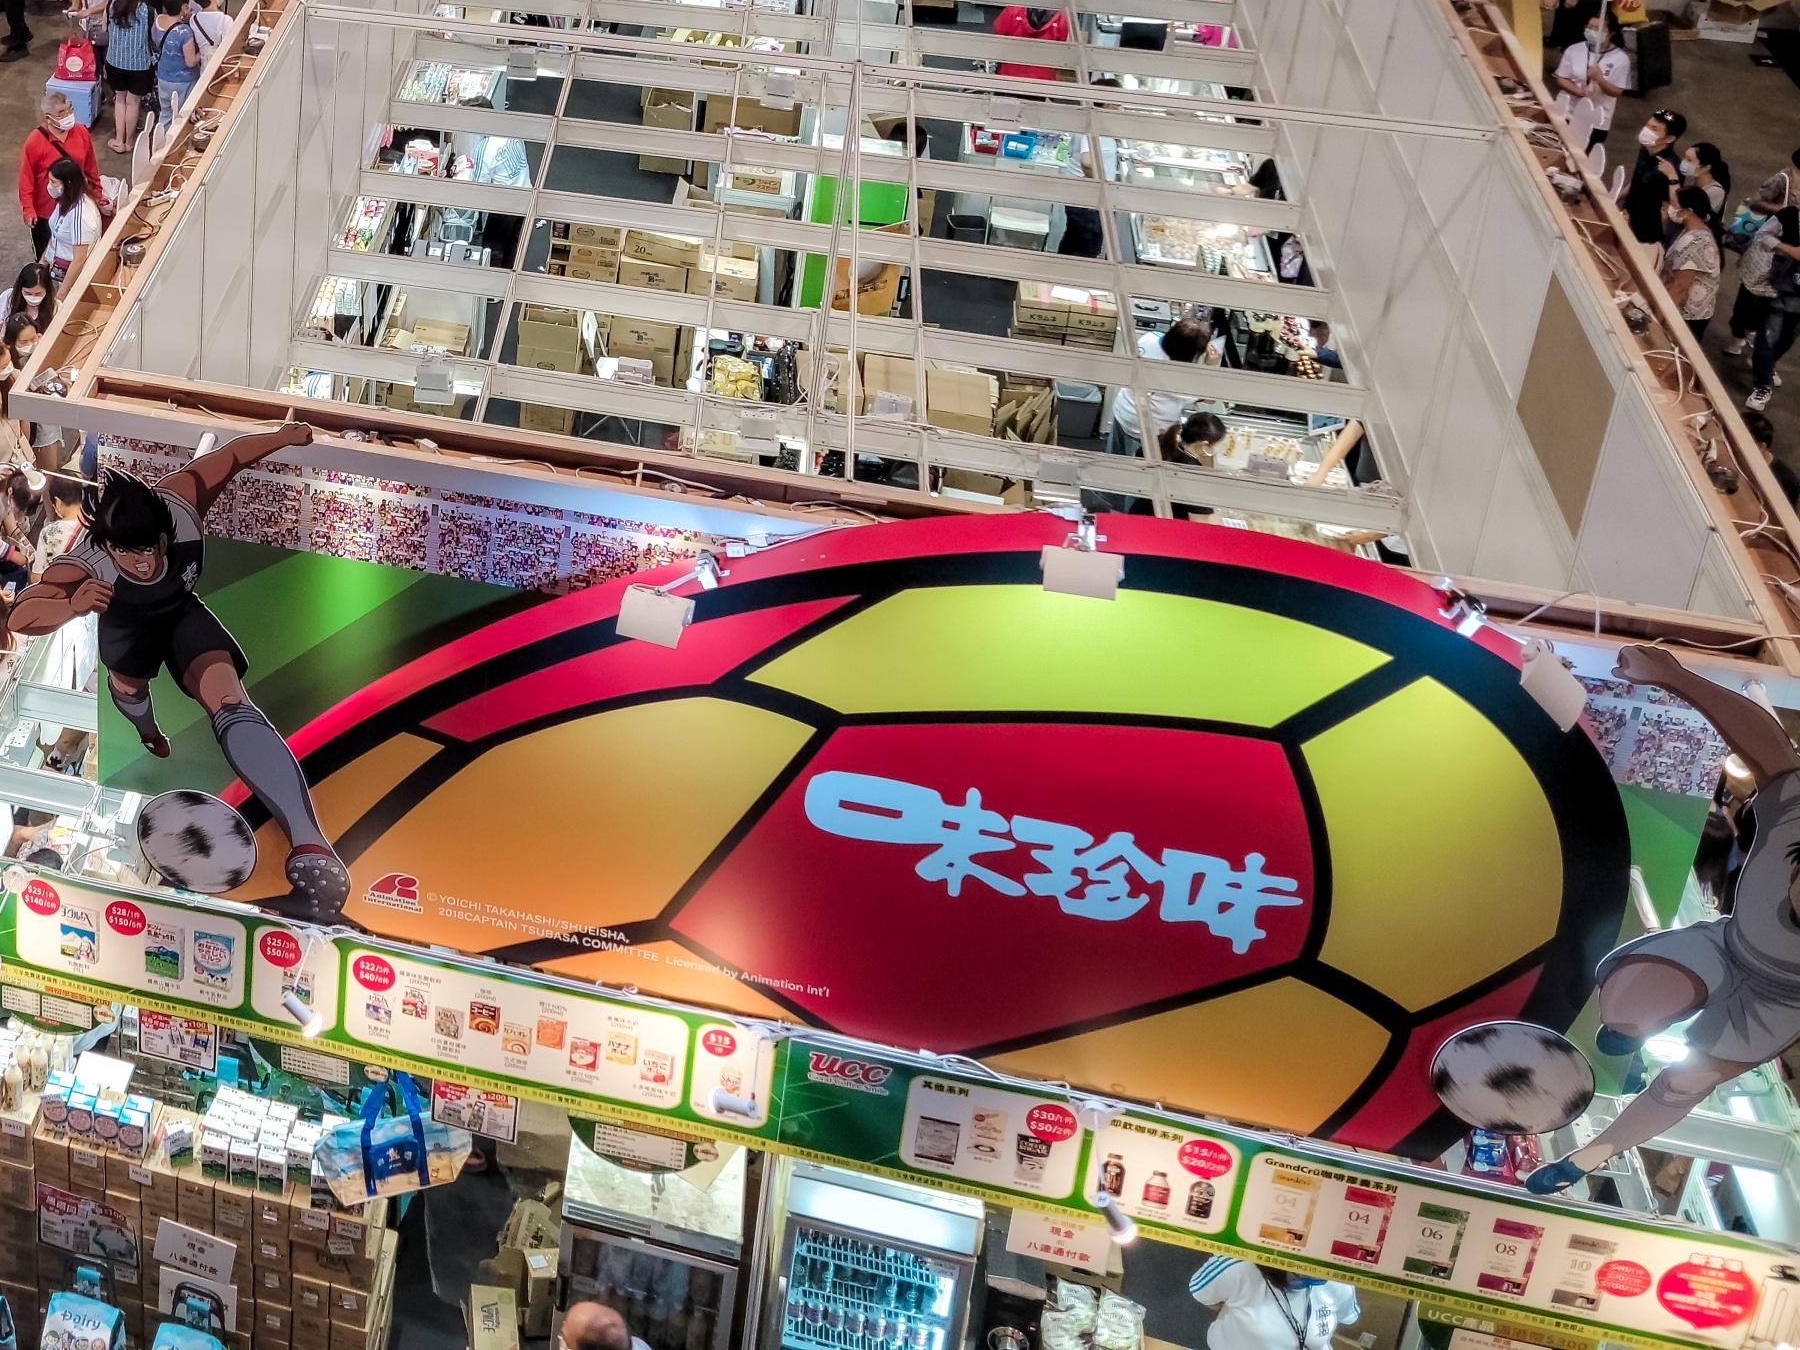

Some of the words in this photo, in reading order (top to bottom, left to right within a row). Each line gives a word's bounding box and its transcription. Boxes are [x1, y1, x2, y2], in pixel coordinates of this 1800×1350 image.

[803, 769, 1304, 954] 味珍味
[362, 895, 424, 914] International
[368, 890, 418, 907] Animation
[439, 893, 484, 913] YOICHI
[484, 903, 631, 945] TAKAHASHI/SHUEISHA,
[437, 906, 519, 932] 2018CAPTAIN
[520, 923, 580, 946] TSUBASA
[581, 934, 661, 962] COMMITTEE
[664, 955, 721, 975] Licensed
[722, 966, 740, 982] by
[740, 969, 805, 994] Animation
[708, 1033, 730, 1047] $15
[808, 1050, 893, 1086] UCC
[921, 1079, 970, 1098] 其他系列
[1348, 1209, 1371, 1225] 04
[1420, 1226, 1444, 1242] 06
[1495, 1241, 1519, 1257] 08
[60, 1308, 103, 1332] Dairy
